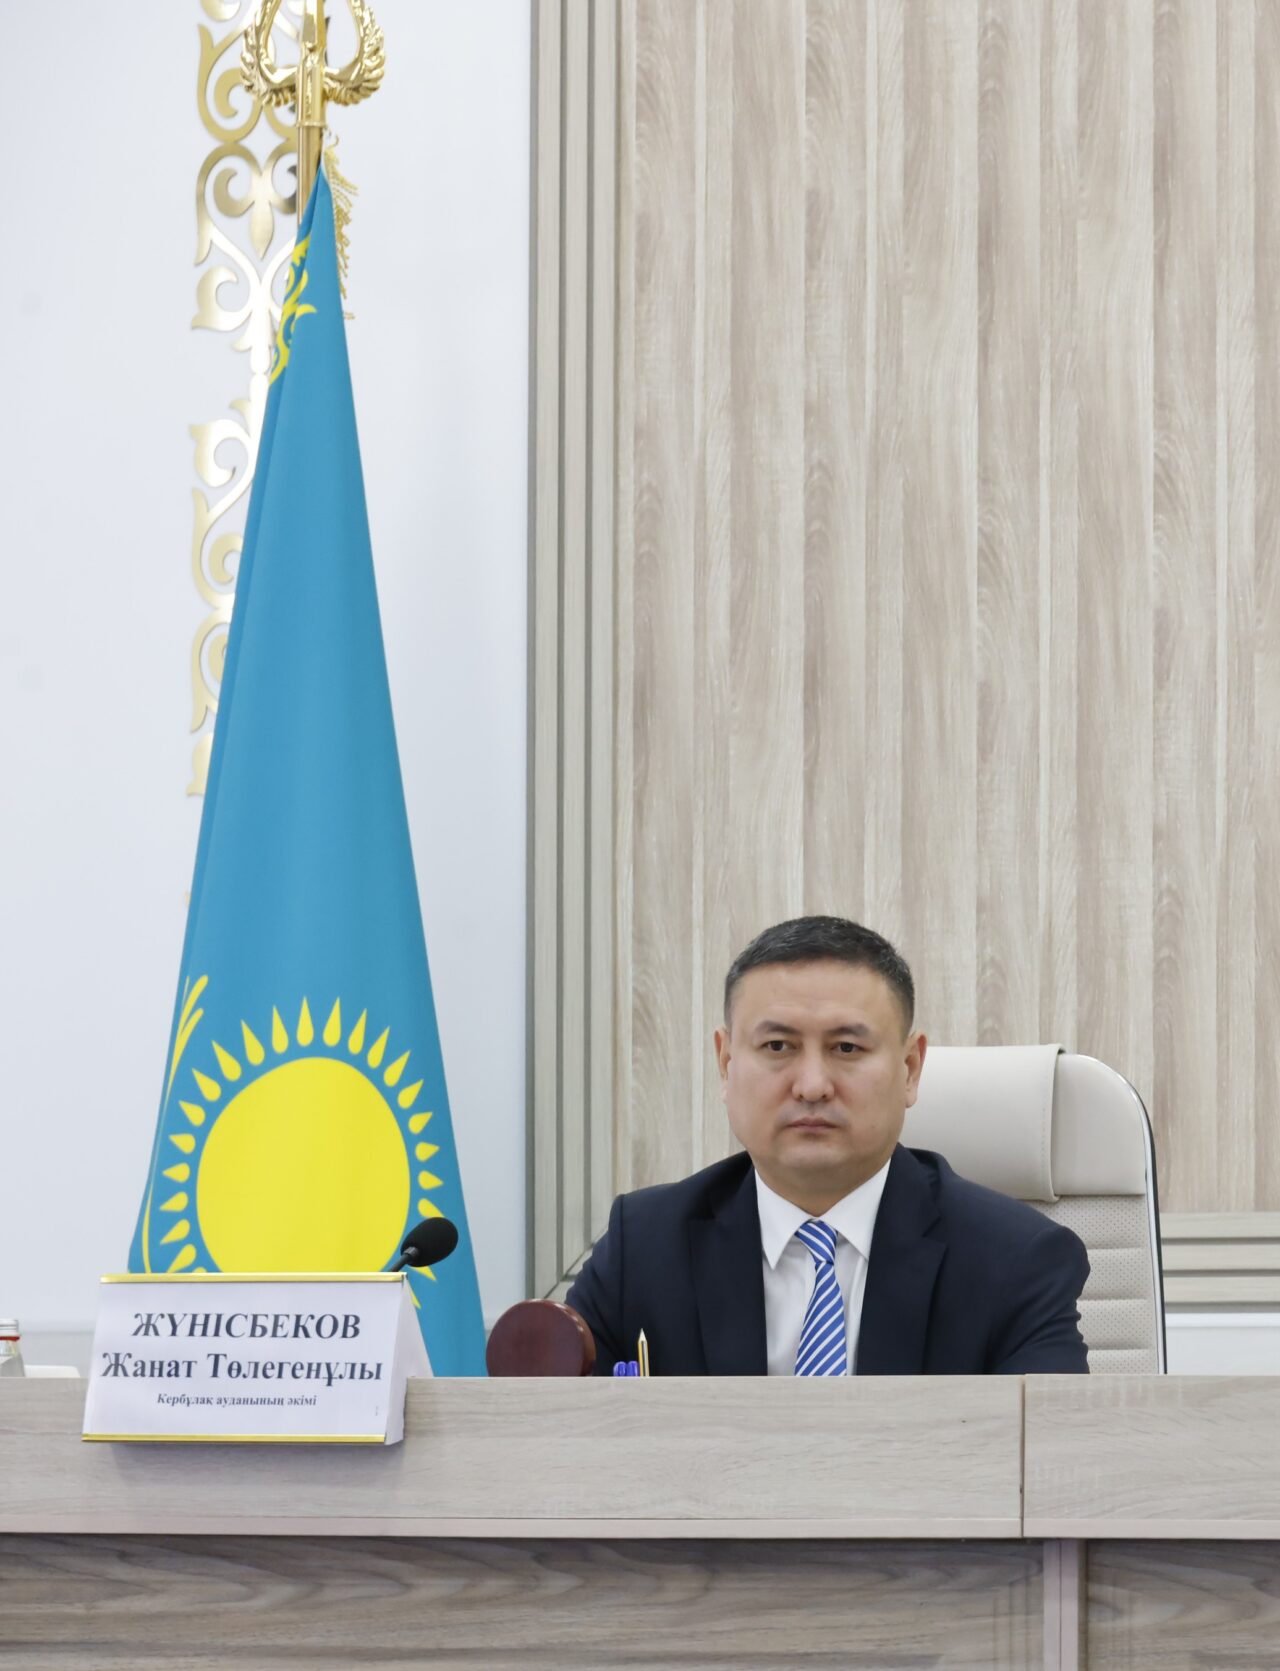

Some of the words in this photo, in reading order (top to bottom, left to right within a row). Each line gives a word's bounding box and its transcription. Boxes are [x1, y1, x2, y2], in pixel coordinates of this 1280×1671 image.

[132, 1312, 361, 1339] ЖҮНІСБЕКОВ
[101, 1352, 198, 1378] Жанат
[206, 1353, 383, 1387] Төлегенұлы
